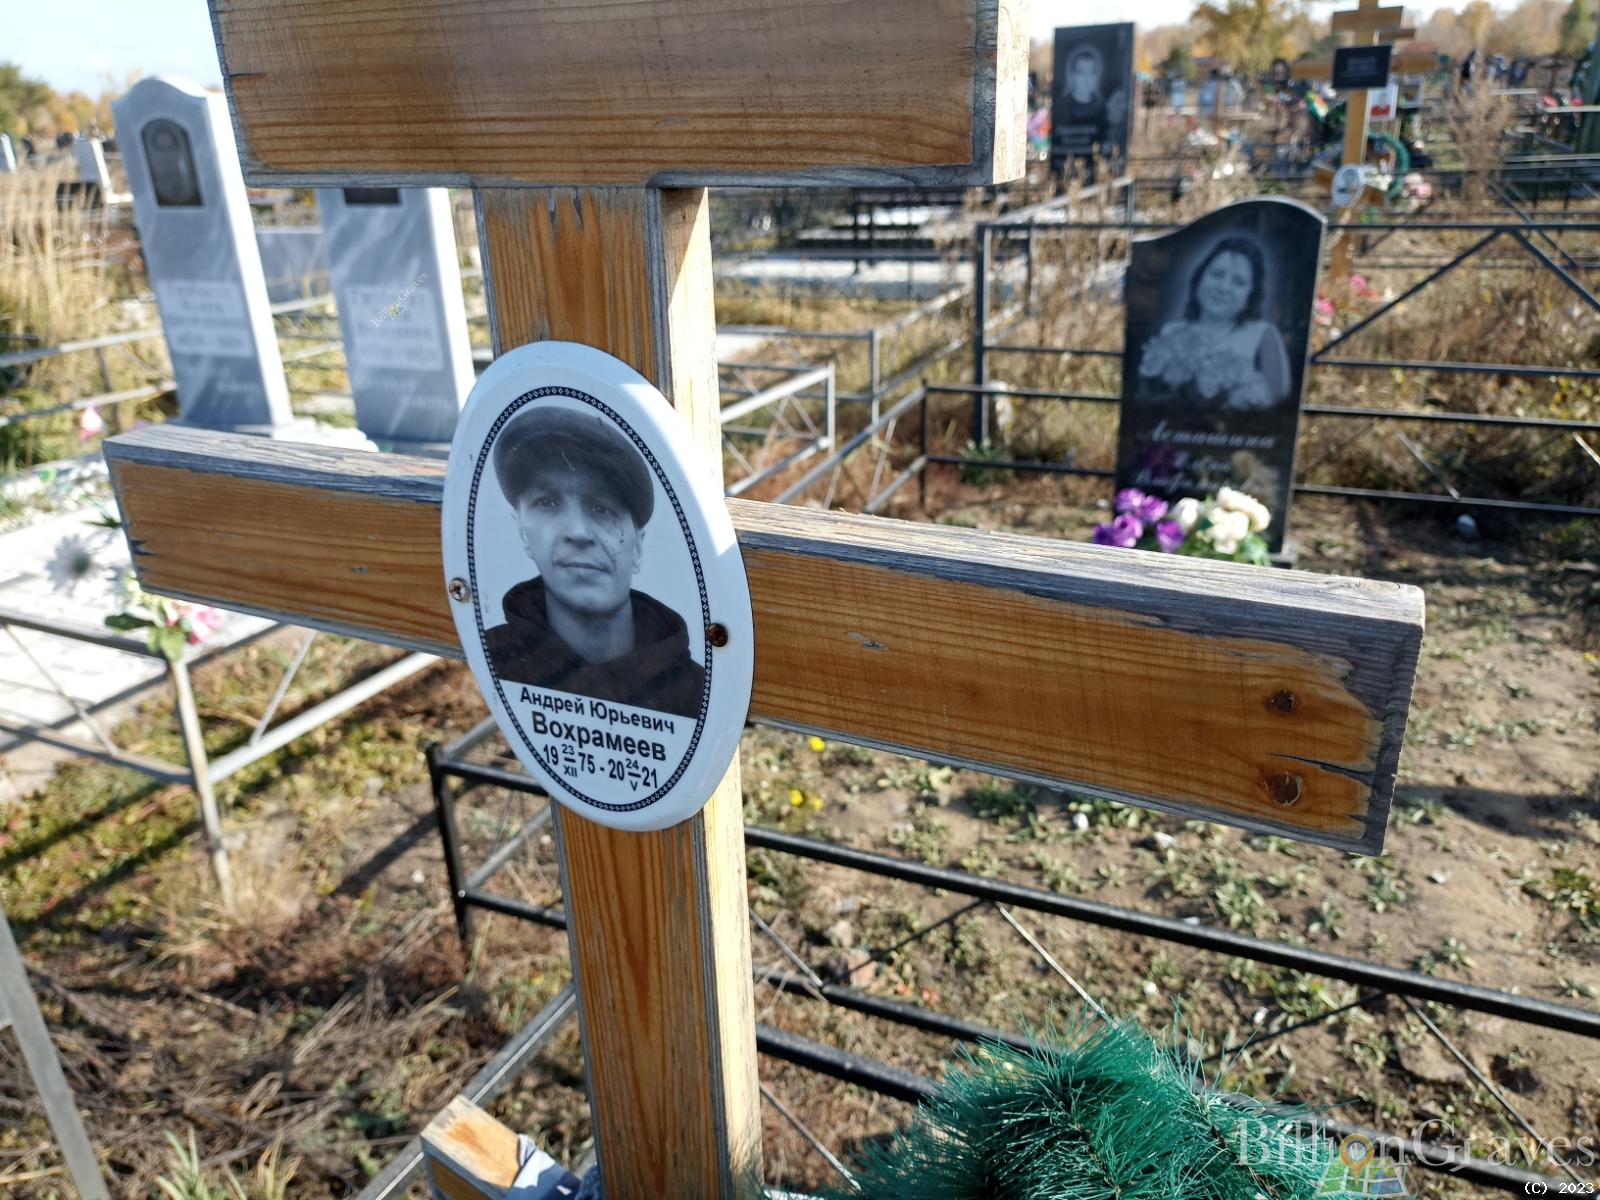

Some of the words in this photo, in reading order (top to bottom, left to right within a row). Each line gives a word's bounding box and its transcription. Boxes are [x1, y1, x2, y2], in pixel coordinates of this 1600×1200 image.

[520, 686, 585, 715] Андрей
[590, 701, 676, 735] Юрьевич
[531, 710, 668, 762] Вохрамеев
[543, 744, 559, 766] 19
[561, 743, 575, 755] 23
[578, 752, 596, 775] 75
[608, 758, 625, 781] 20
[625, 758, 639, 770] 24
[630, 780, 638, 792] V
[641, 766, 658, 789] 21
